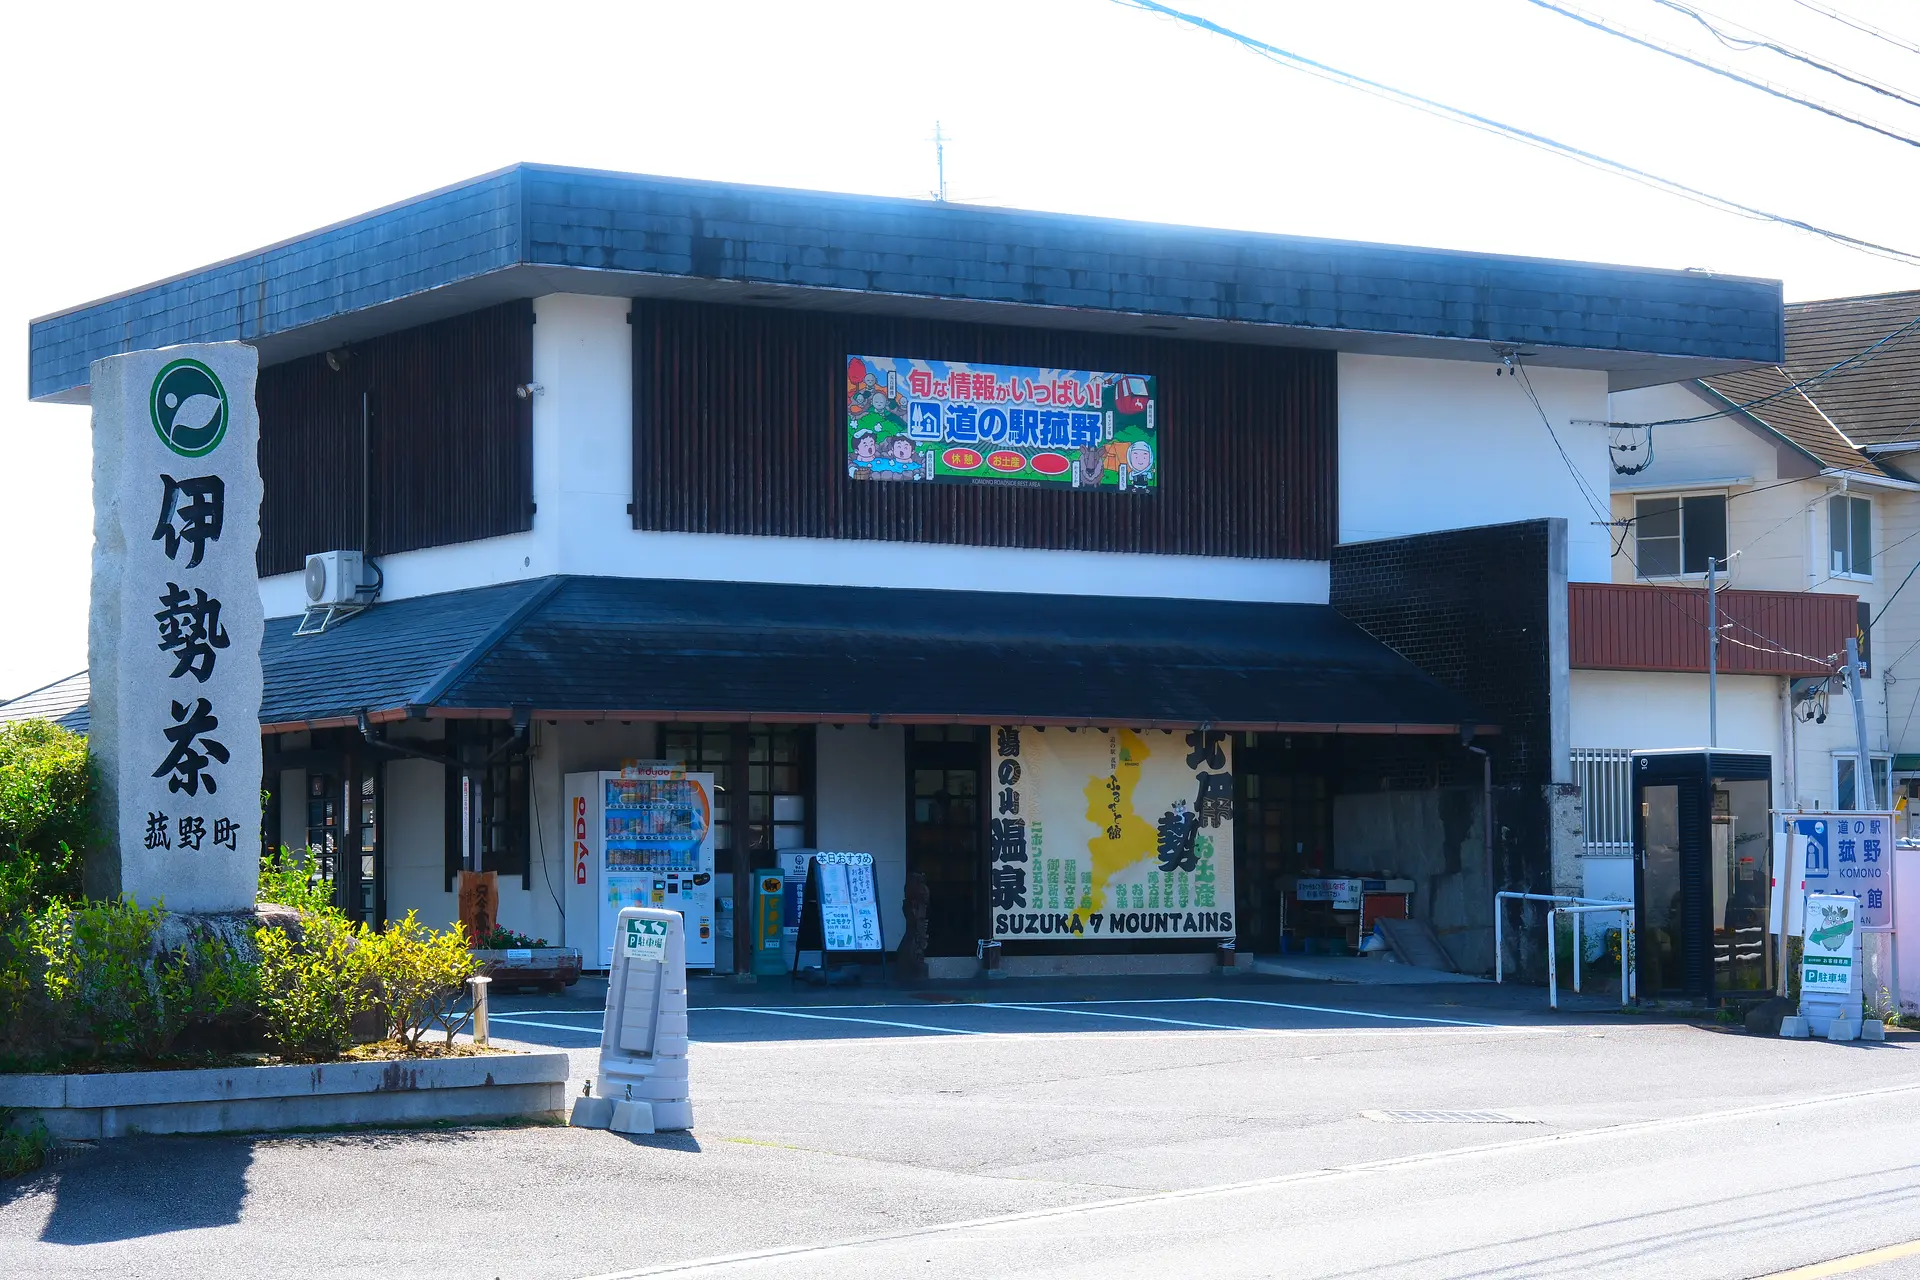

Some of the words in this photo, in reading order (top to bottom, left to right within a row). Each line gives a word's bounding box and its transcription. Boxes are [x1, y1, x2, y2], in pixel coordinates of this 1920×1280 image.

[908, 369, 1102, 407] 旬な情報がいっぱい!
[945, 404, 1102, 449] 道の駅菰野
[951, 453, 974, 465] 休憩
[993, 455, 1021, 468] お土産
[151, 473, 231, 796] 伊勢茶
[144, 811, 241, 852] 菰野町
[1837, 819, 1882, 835] 道の駅
[817, 853, 872, 865] 本日おすすめ
[1838, 839, 1882, 863] 菰野
[1031, 821, 1044, 909] ニホンカモシカ
[1194, 835, 1216, 908] お土産
[1839, 868, 1882, 878] KOMONO
[1115, 883, 1129, 909] お米
[862, 917, 874, 941] お米
[995, 913, 1084, 934] SUZUKA
[1089, 913, 1104, 934] 7
[1109, 912, 1233, 934] MOUNTAINS
[1818, 971, 1848, 984] 駐車場
